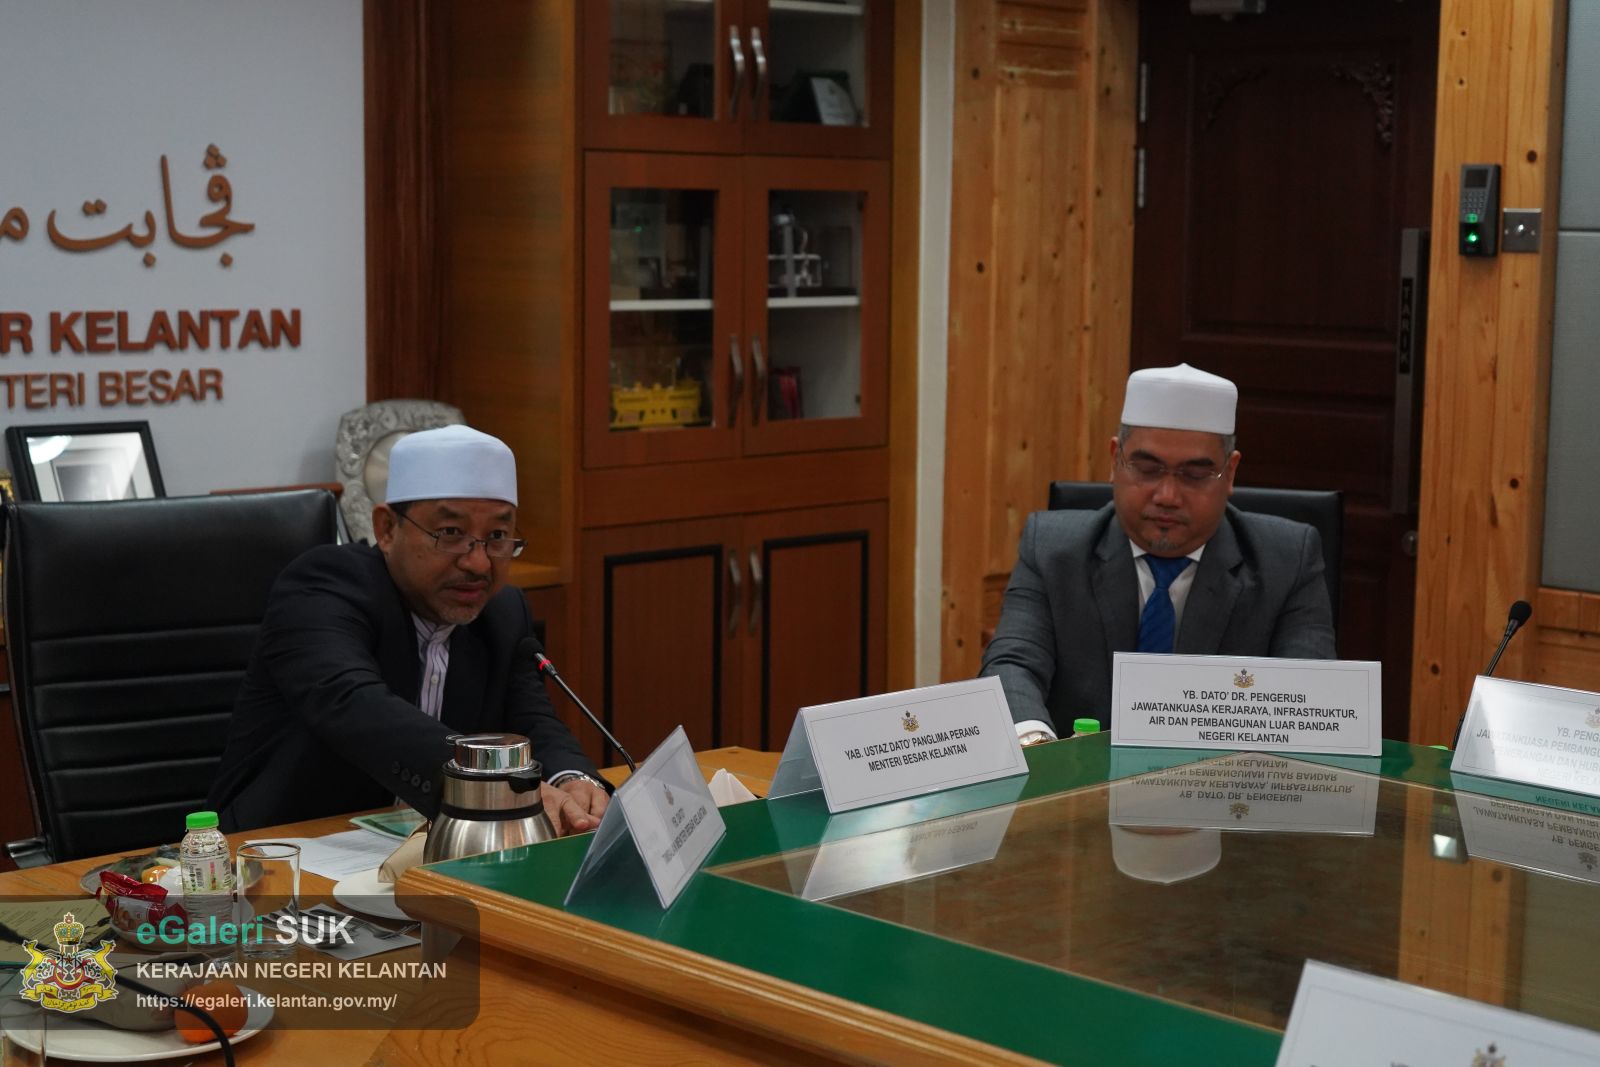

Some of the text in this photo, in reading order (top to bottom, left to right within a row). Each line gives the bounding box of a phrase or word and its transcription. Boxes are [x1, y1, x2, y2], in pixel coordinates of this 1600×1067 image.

[50, 308, 302, 355] KELANTAN
[98, 368, 224, 407] BESAR
[1182, 690, 1306, 703] YB. DATO' DR. PENGERUSI
[1131, 701, 1358, 720] JAWATANKUASA KERJARAYA, INFRASTRUKTUR,
[1149, 716, 1340, 732] AIR DAN PEMBANGUNAN LUAR BANDAR
[844, 725, 981, 760] YAB. USTAZ DATO' PANGLIMA PERANG
[1198, 731, 1289, 743] NEGERI KELANTAN
[1556, 726, 1600, 743] YB. PENG
[868, 743, 968, 772] MENTERI BESAR KELANTAN
[1578, 759, 1600, 773] HUB
